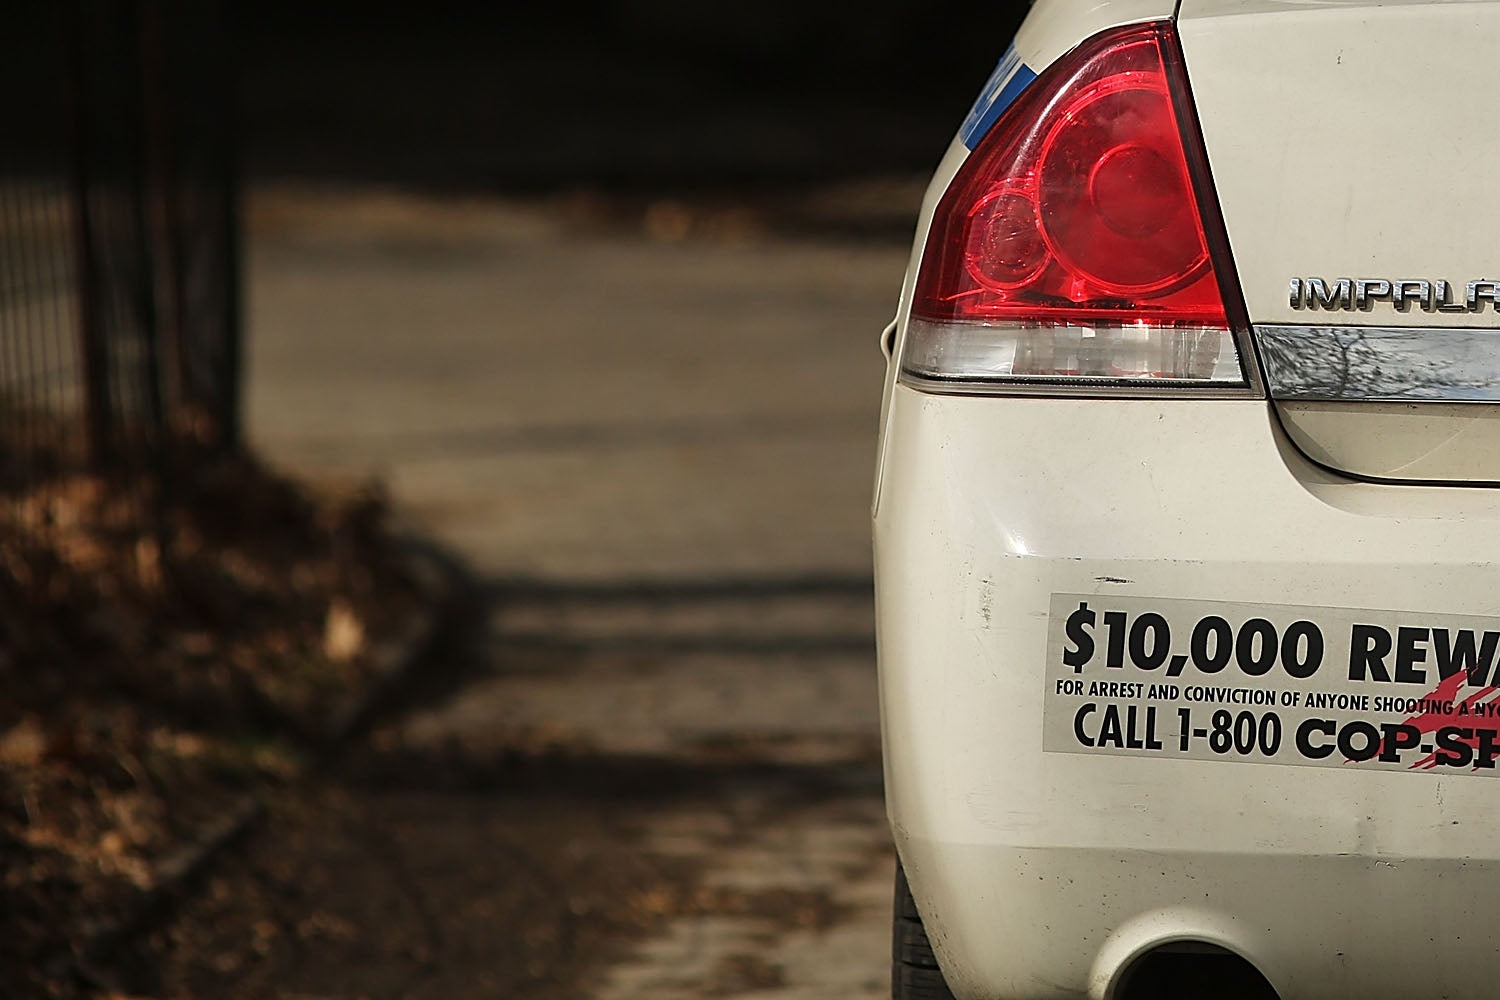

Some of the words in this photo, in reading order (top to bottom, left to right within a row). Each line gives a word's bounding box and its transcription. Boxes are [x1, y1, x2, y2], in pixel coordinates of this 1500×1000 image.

[1062, 601, 1324, 679] $10,000
[1056, 680, 1084, 695] FOR
[1088, 681, 1144, 699] ARREST
[1149, 685, 1180, 700] AND
[1184, 686, 1277, 706] CONVICTION
[1281, 691, 1300, 707] OF
[1304, 692, 1370, 711] ANYONE
[1374, 697, 1453, 716] SHOOTING
[1459, 702, 1469, 716] A
[1074, 703, 1162, 750] CALL
[1177, 708, 1282, 756] 1-800
